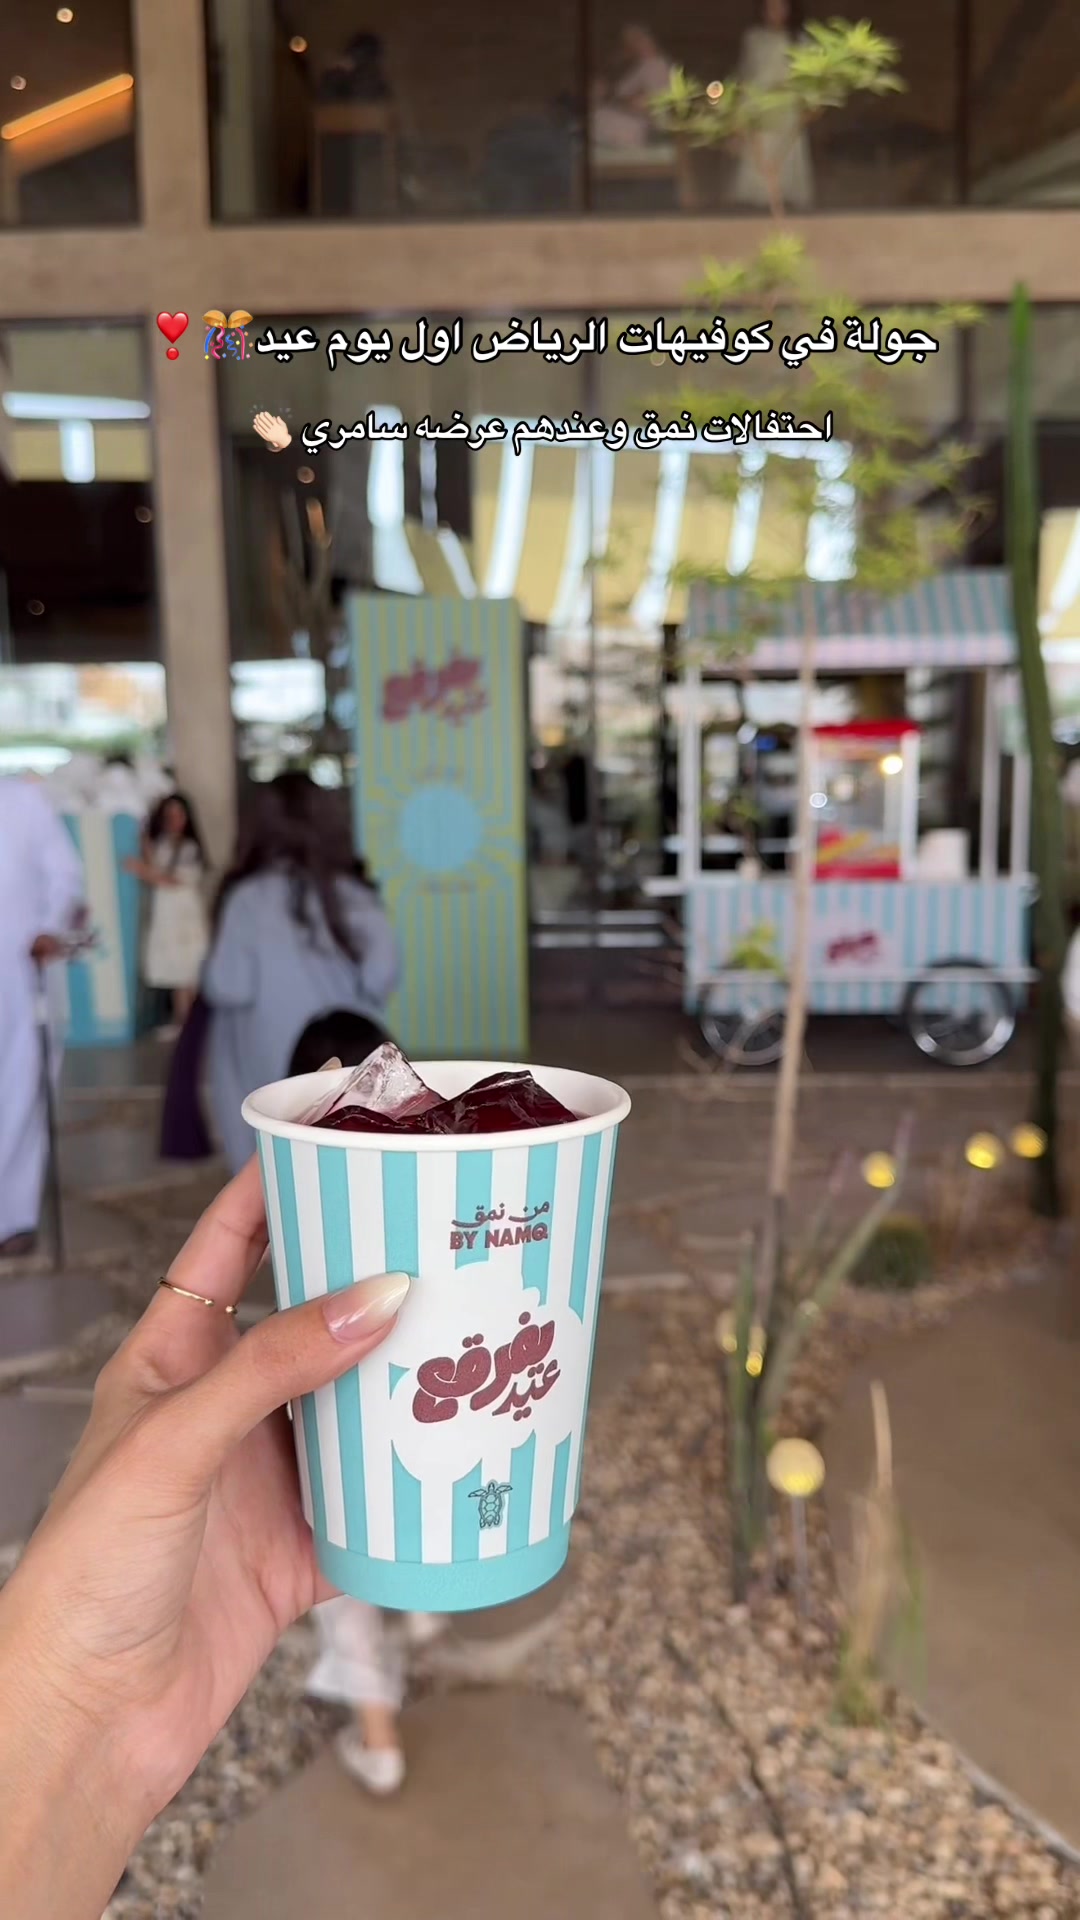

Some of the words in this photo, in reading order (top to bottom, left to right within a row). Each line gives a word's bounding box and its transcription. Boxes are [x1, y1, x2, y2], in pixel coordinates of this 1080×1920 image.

[451, 1201, 506, 1229] نمق
[508, 1200, 551, 1223] من
[449, 1230, 479, 1251] BY
[484, 1221, 549, 1249] NAMQ
